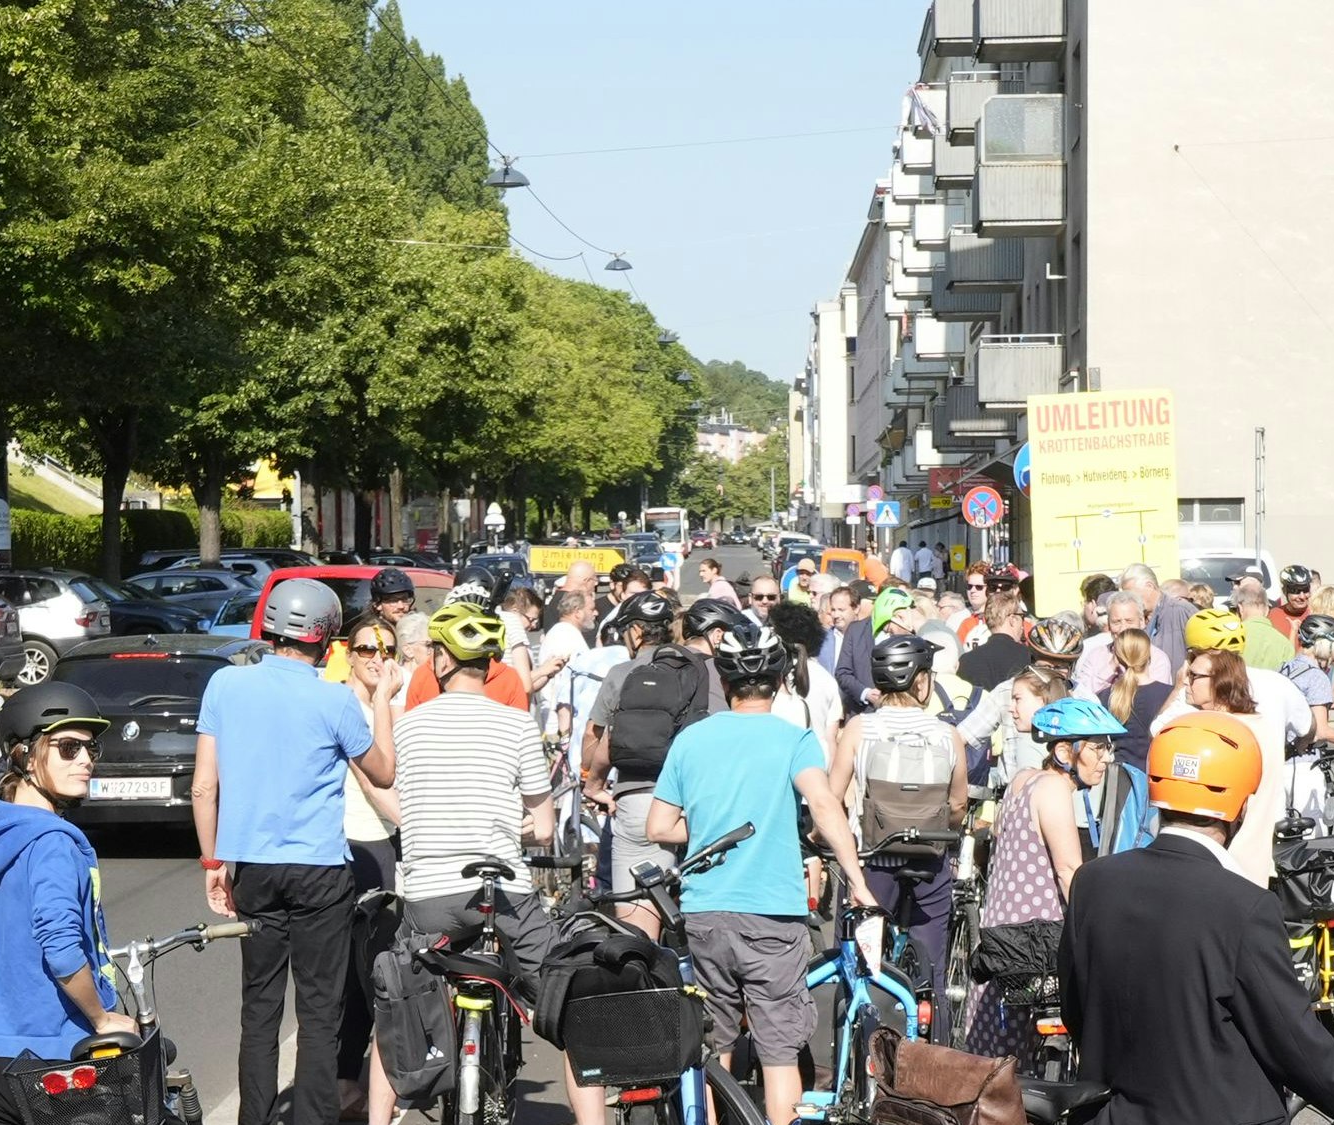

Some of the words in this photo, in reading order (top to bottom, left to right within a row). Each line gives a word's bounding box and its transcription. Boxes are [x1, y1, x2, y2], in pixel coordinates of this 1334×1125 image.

[1036, 397, 1170, 433] UMLEITUNG
[1038, 432, 1170, 454] KROTTENBACHSTRAßE
[542, 549, 604, 561] Umleitung
[1175, 758, 1197, 768] WIEN
